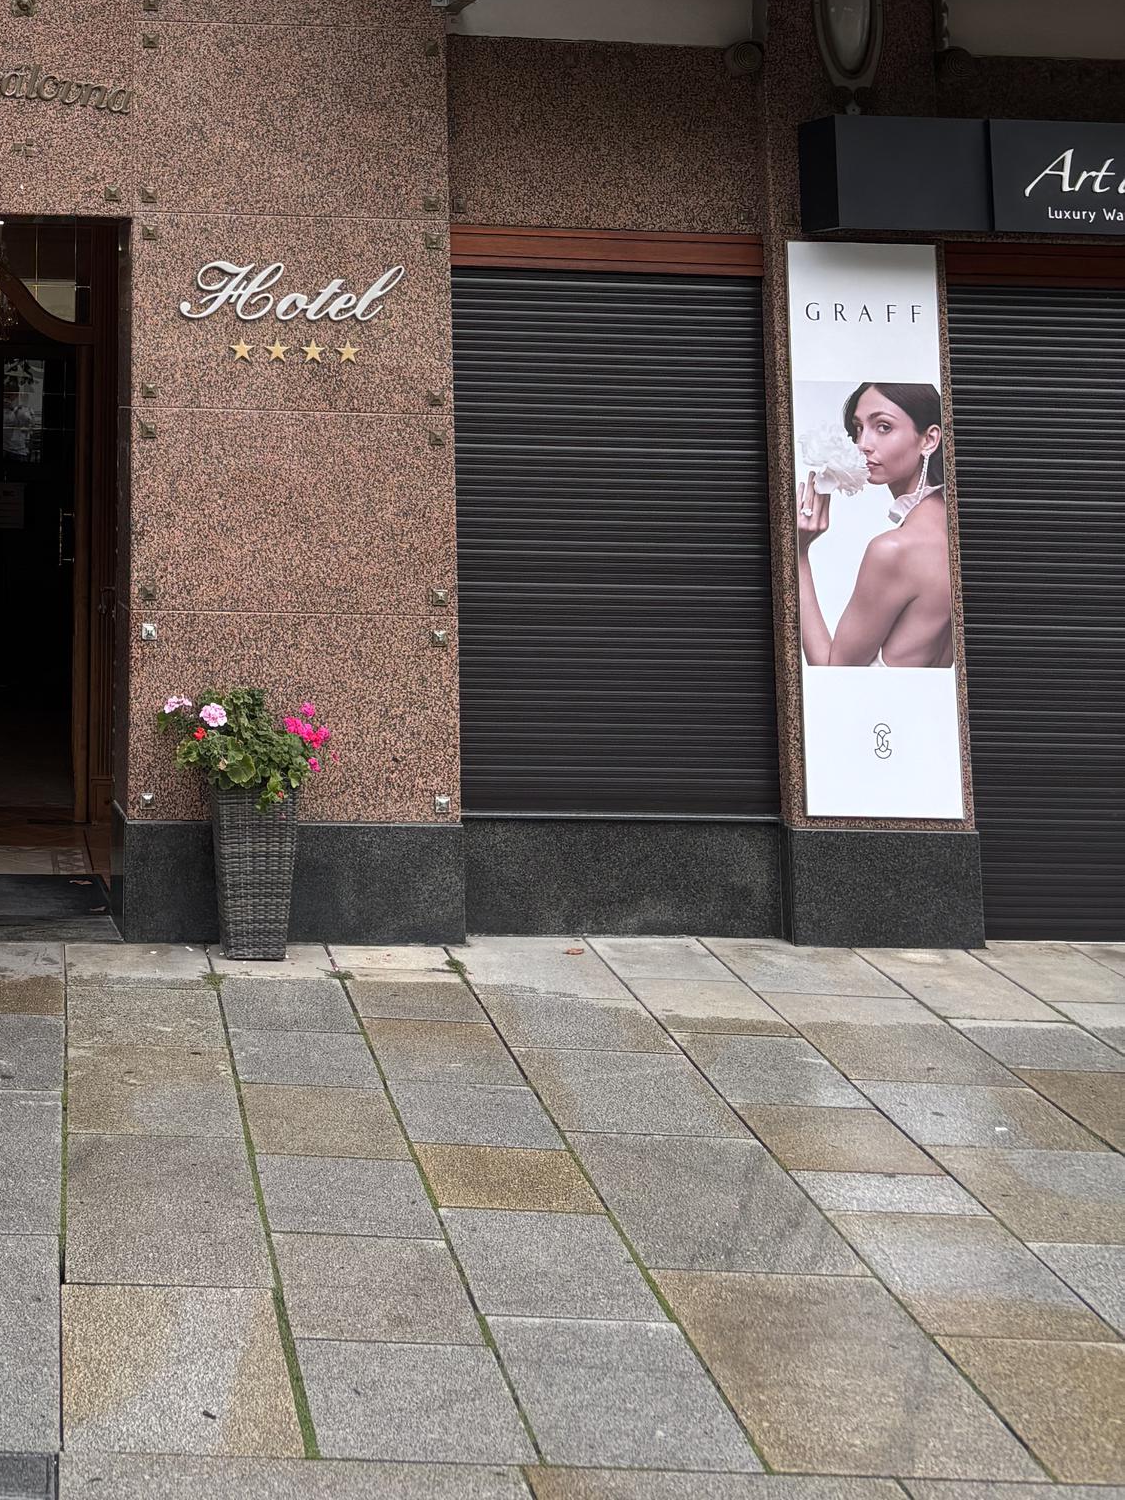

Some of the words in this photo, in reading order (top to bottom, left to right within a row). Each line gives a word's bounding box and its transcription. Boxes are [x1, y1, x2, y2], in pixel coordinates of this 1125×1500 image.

[1024, 148, 1116, 197] Art
[1048, 206, 1096, 223] Luxury
[180, 261, 405, 321] Hotel
[805, 302, 922, 323] GRAFF
